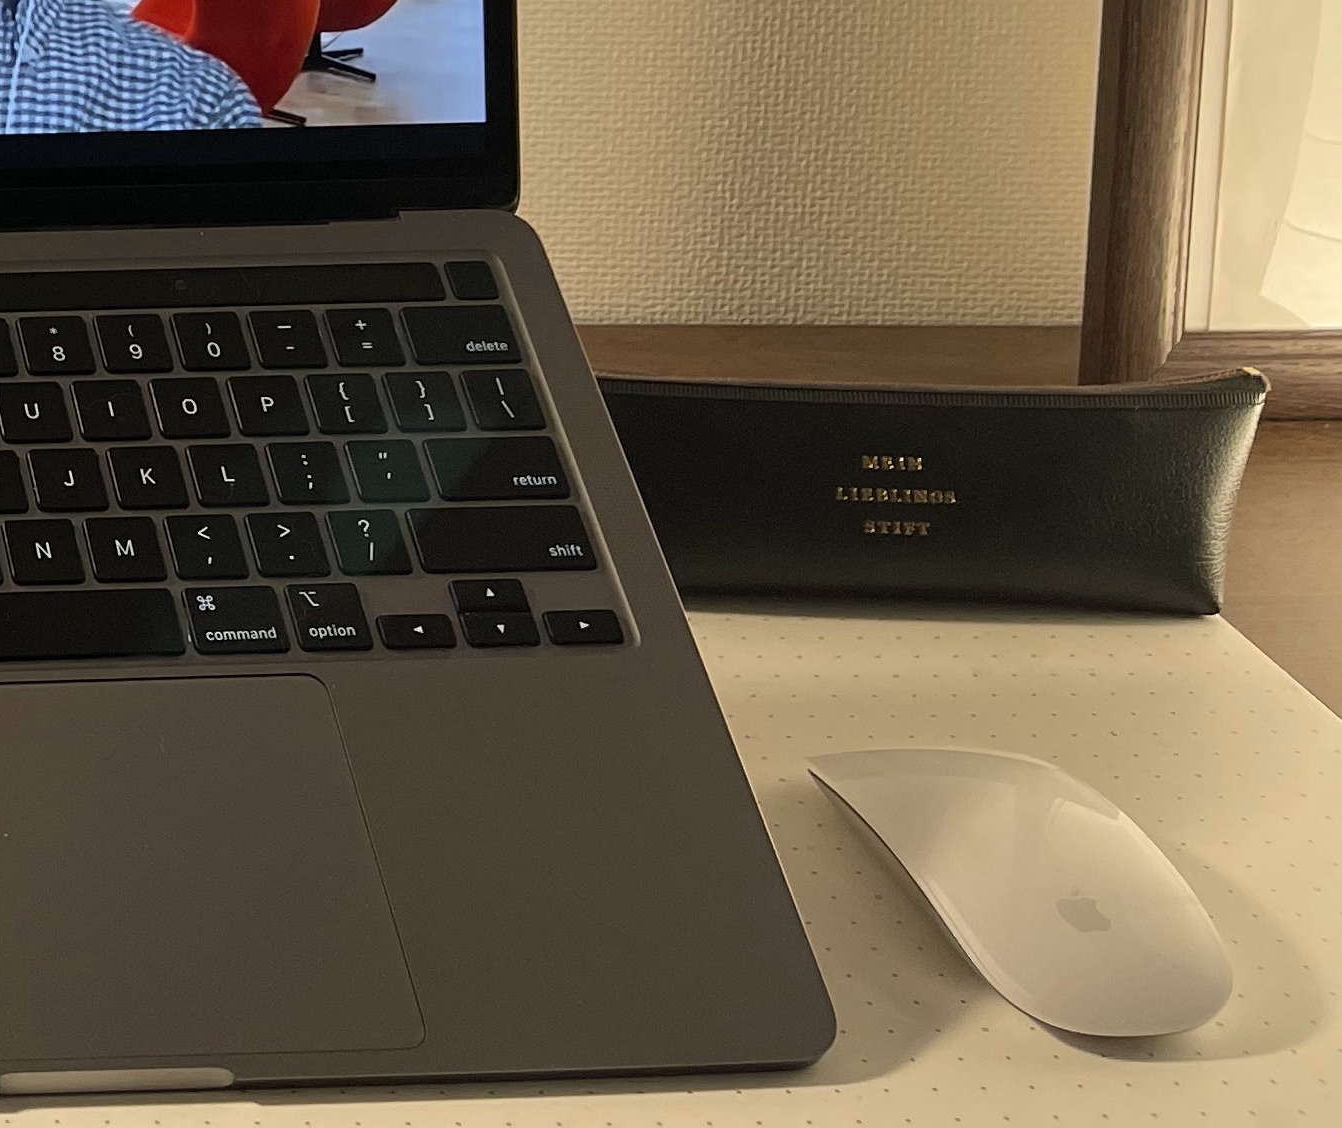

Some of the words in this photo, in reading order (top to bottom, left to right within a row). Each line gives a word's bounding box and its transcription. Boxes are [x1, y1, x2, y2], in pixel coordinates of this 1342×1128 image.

[52, 345, 66, 362] 8
[129, 343, 143, 360] 9
[206, 341, 221, 358] 0
[465, 340, 509, 352] delete
[23, 402, 40, 420] U
[107, 401, 115, 417] I
[181, 398, 198, 415] O
[260, 396, 275, 413] P
[861, 455, 923, 471] MEIN
[63, 469, 75, 487] J
[139, 467, 156, 485] K
[220, 465, 236, 482] L
[512, 475, 558, 486] return
[863, 521, 931, 536] STIFT
[35, 541, 53, 559] N
[114, 539, 135, 557] M
[548, 544, 584, 557] shift
[205, 626, 277, 641] command
[308, 624, 357, 639] option
